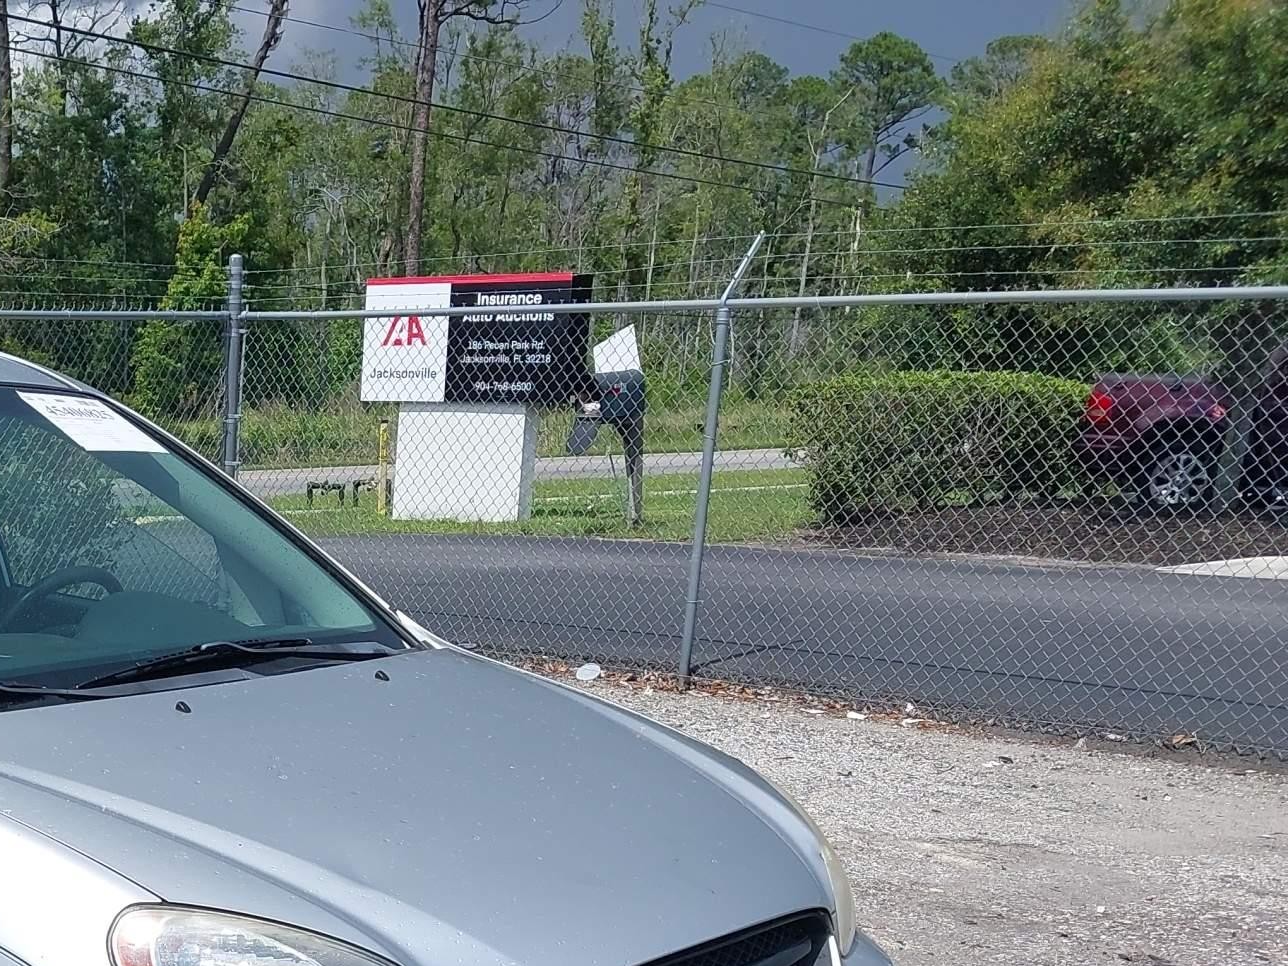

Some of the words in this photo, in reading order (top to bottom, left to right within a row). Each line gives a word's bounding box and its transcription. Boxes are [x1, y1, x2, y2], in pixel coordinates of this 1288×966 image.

[477, 292, 542, 306] Insurance
[467, 340, 483, 350] 186
[484, 340, 510, 350] Pecan
[511, 340, 530, 350] Park
[525, 354, 551, 363] 32218
[370, 367, 437, 379] Jacksonville
